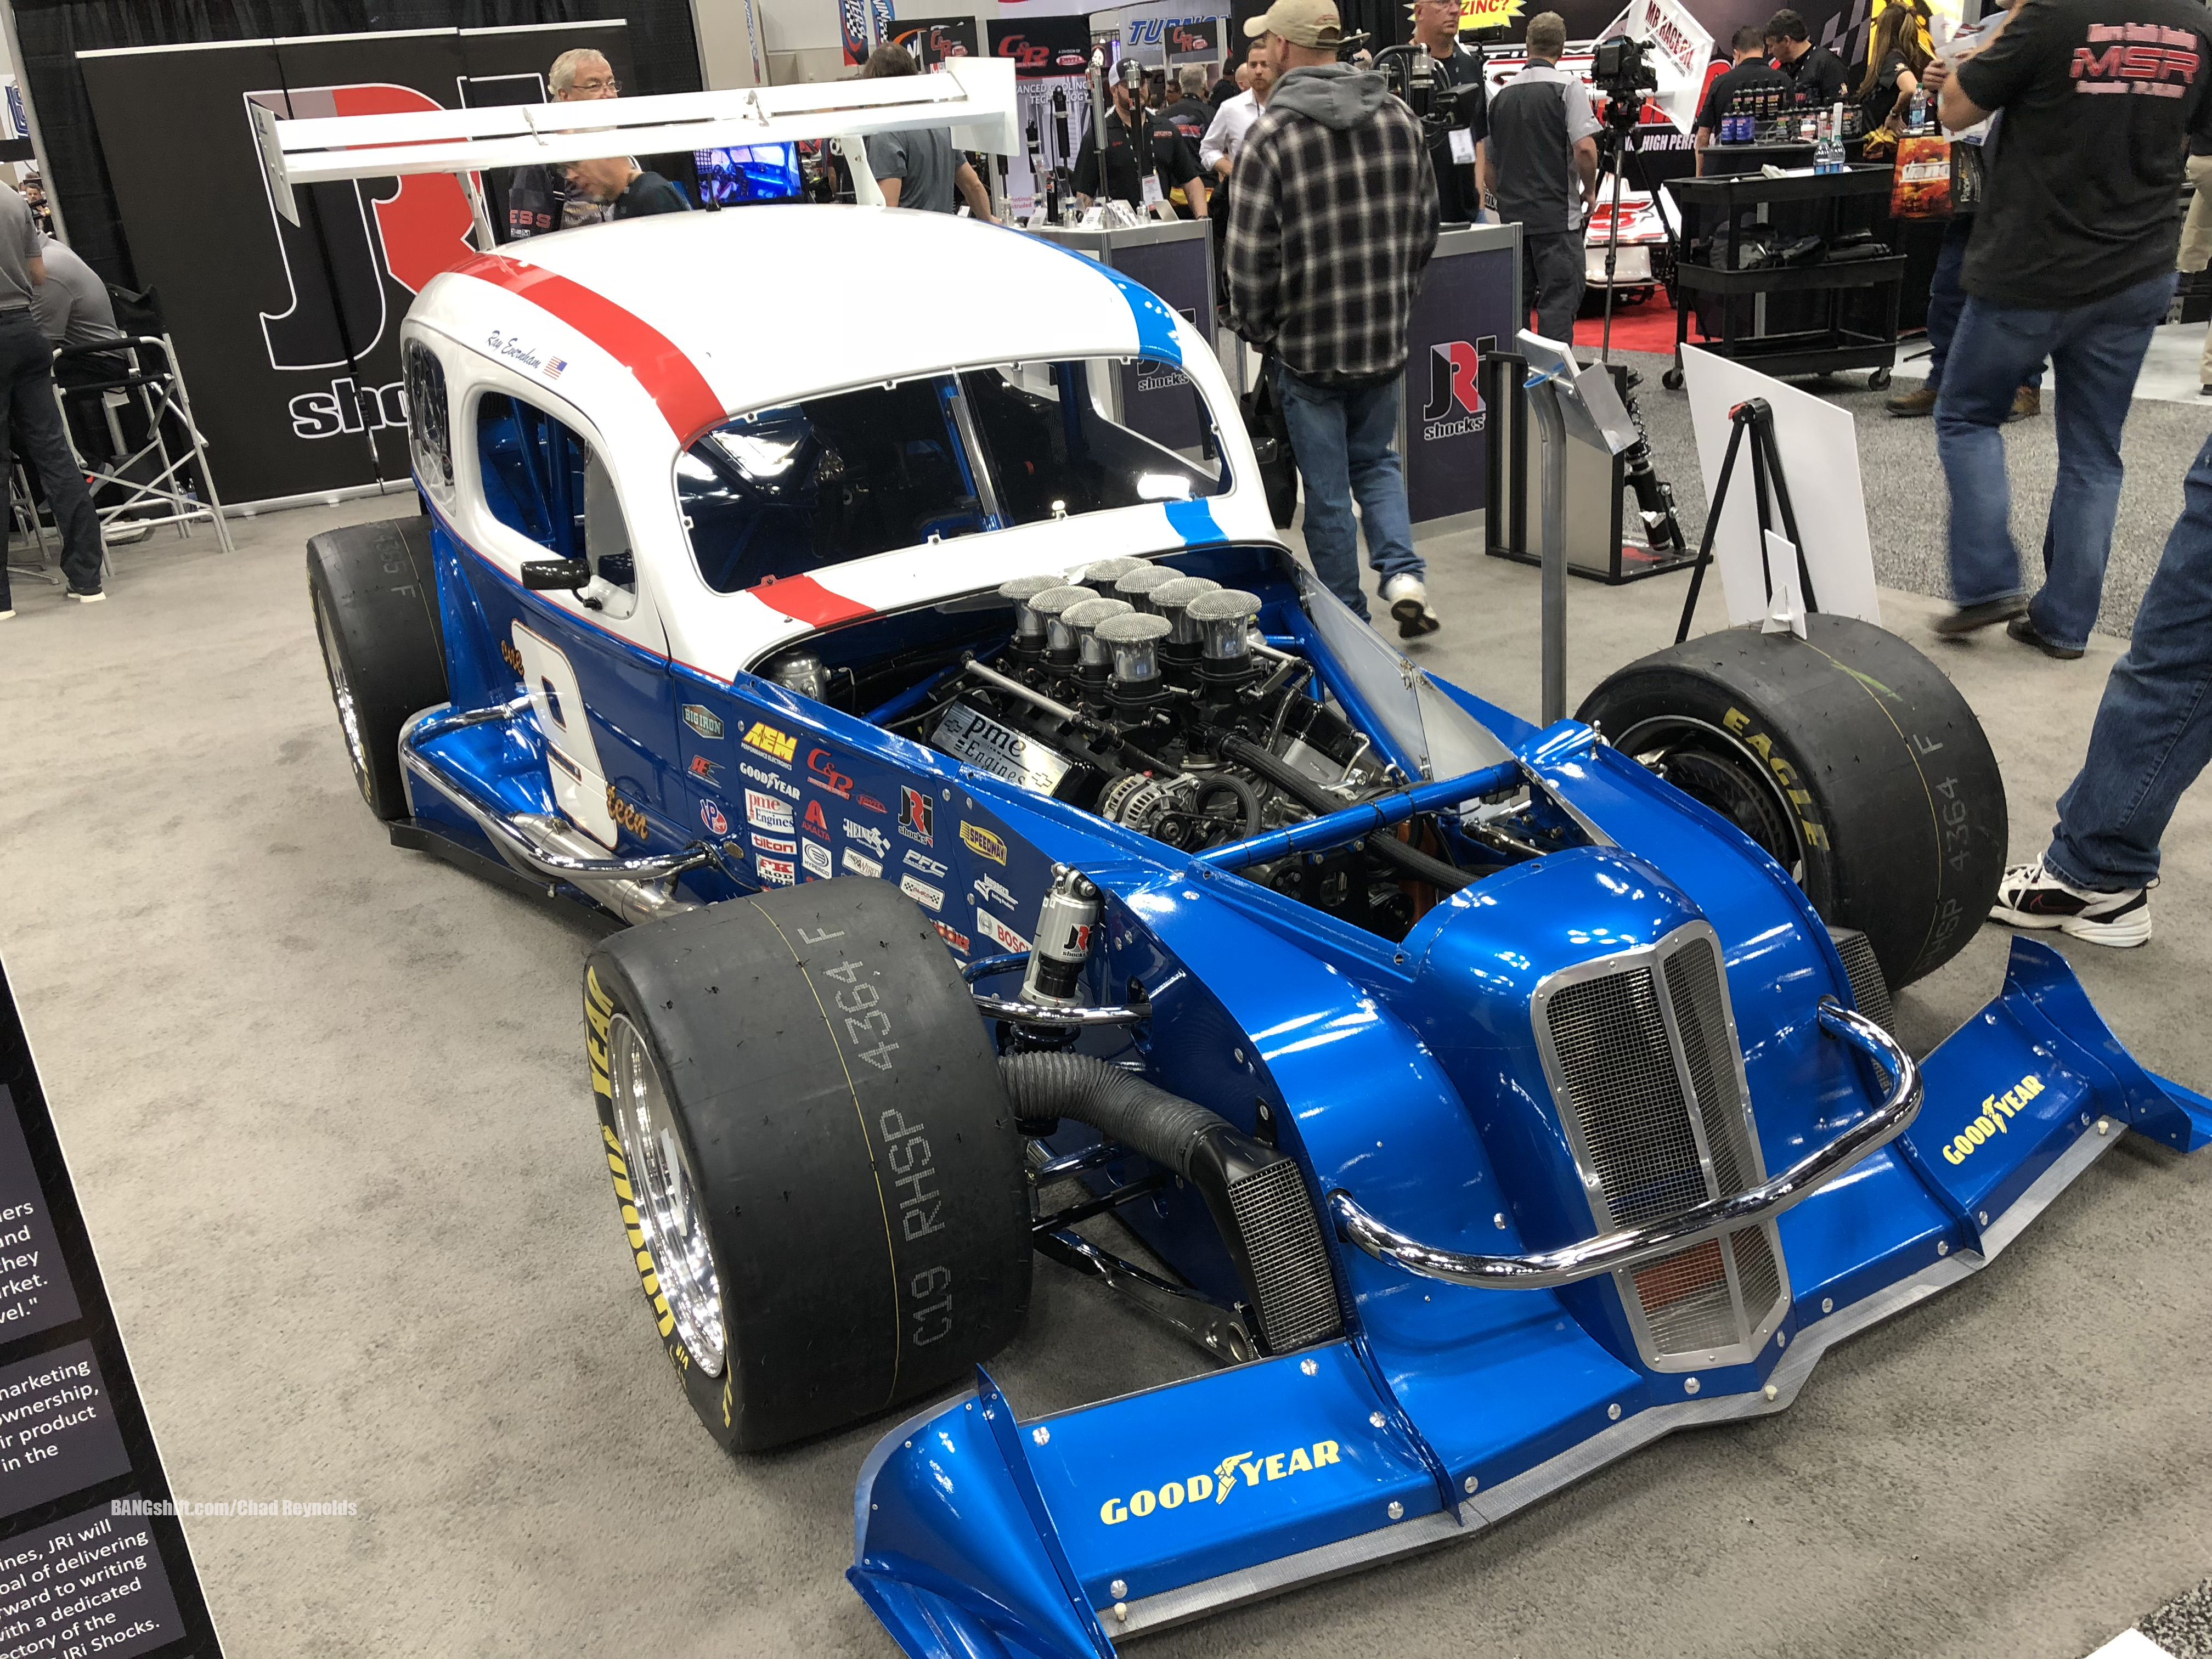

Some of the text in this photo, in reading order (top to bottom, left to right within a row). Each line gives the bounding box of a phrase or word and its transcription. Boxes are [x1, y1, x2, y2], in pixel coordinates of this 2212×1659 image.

[2069, 46, 2200, 84] MSR
[1016, 83, 1047, 94] ANCED
[1030, 92, 1089, 104] TECHLOGY
[1643, 135, 1668, 151] HIGH
[485, 330, 541, 369] Ray Evernham
[1138, 372, 1189, 391] shocks
[1424, 416, 1485, 441] shocks
[390, 584, 417, 599] F
[684, 708, 698, 725] BIG
[699, 714, 721, 735] IRON
[962, 714, 1026, 758] pme
[741, 742, 792, 771] PERFORMANCE ELECTRONICS
[742, 720, 798, 763] AEM
[1912, 733, 1944, 755] F
[808, 748, 854, 792] C&R
[964, 740, 1026, 786] Engines
[1723, 706, 1830, 851] EAGLE
[740, 761, 800, 801] GOODYEAR
[748, 793, 781, 812] pme
[755, 807, 794, 828] Engines
[898, 785, 933, 836] JRi
[802, 821, 831, 842] AXALTA
[898, 825, 928, 845] shocks
[1936, 776, 1971, 872] 4364
[753, 834, 794, 853] tilton
[969, 826, 1006, 862] SPEEDWAY
[760, 858, 793, 873] FK
[764, 868, 793, 879] ROD
[804, 860, 830, 877] HYPERCO
[905, 849, 949, 876] PFC
[1943, 1075, 2045, 1165] GOODYEAR
[584, 964, 675, 1339] GOODYEAR
[797, 926, 952, 1346] C19 RHSP 4364 F
[0, 1202, 34, 1223] ers
[19, 1406, 97, 1446] product
[1, 1444, 59, 1472] in the
[1101, 1440, 1341, 1525] GOODYEAR
[49, 1533, 75, 1554] JRi
[78, 1518, 112, 1542] will
[32, 1564, 51, 1583] of
[55, 1531, 149, 1575] delivering
[55, 1582, 76, 1598] to
[80, 1555, 148, 1588] writing
[35, 1616, 47, 1628] a
[51, 1576, 142, 1622] dedicated
[61, 1621, 80, 1641] of
[84, 1612, 117, 1632] the
[91, 1618, 160, 1652] Shocks.
